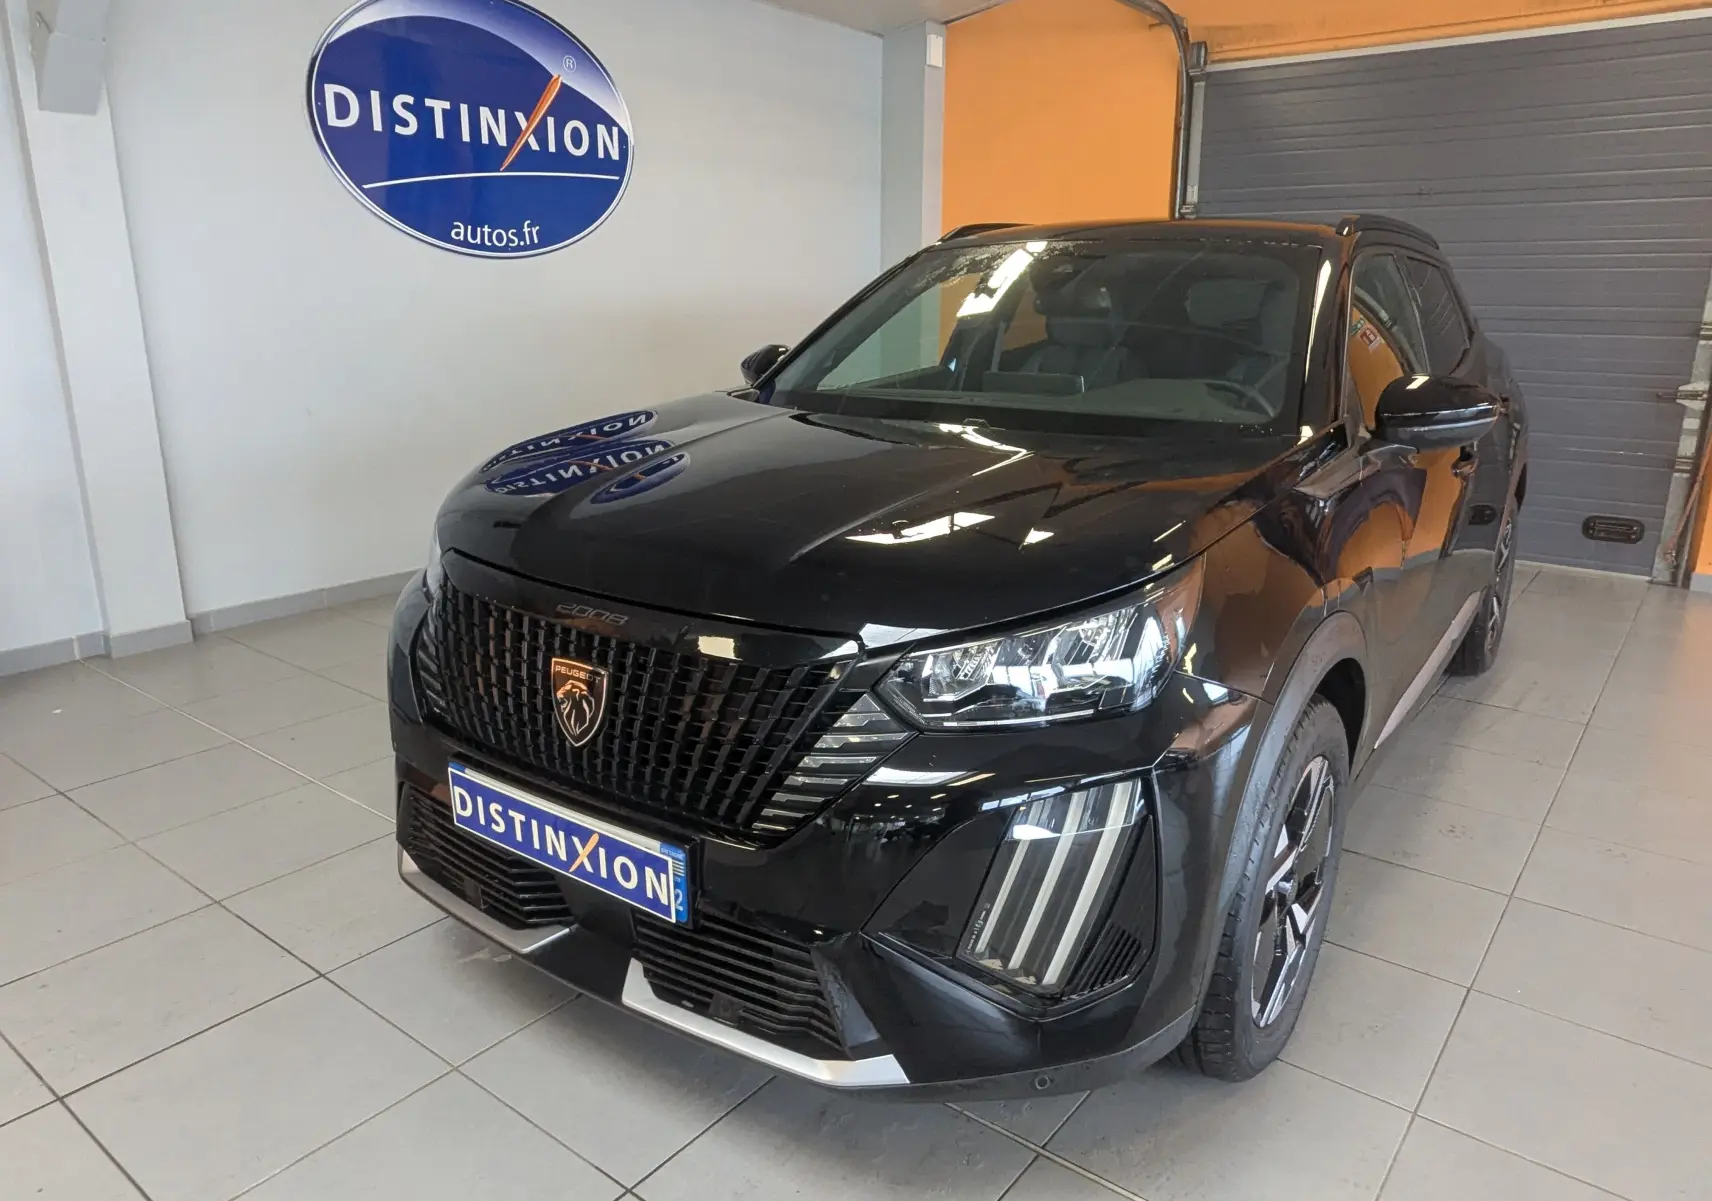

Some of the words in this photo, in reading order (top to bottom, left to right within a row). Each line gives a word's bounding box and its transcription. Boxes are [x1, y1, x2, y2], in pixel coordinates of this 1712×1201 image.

[323, 75, 620, 171] DISTINXION
[450, 220, 540, 247] autos.fr
[555, 603, 629, 626] 2008
[554, 665, 602, 684] PEUGEOT
[453, 785, 670, 906] DISTINXION
